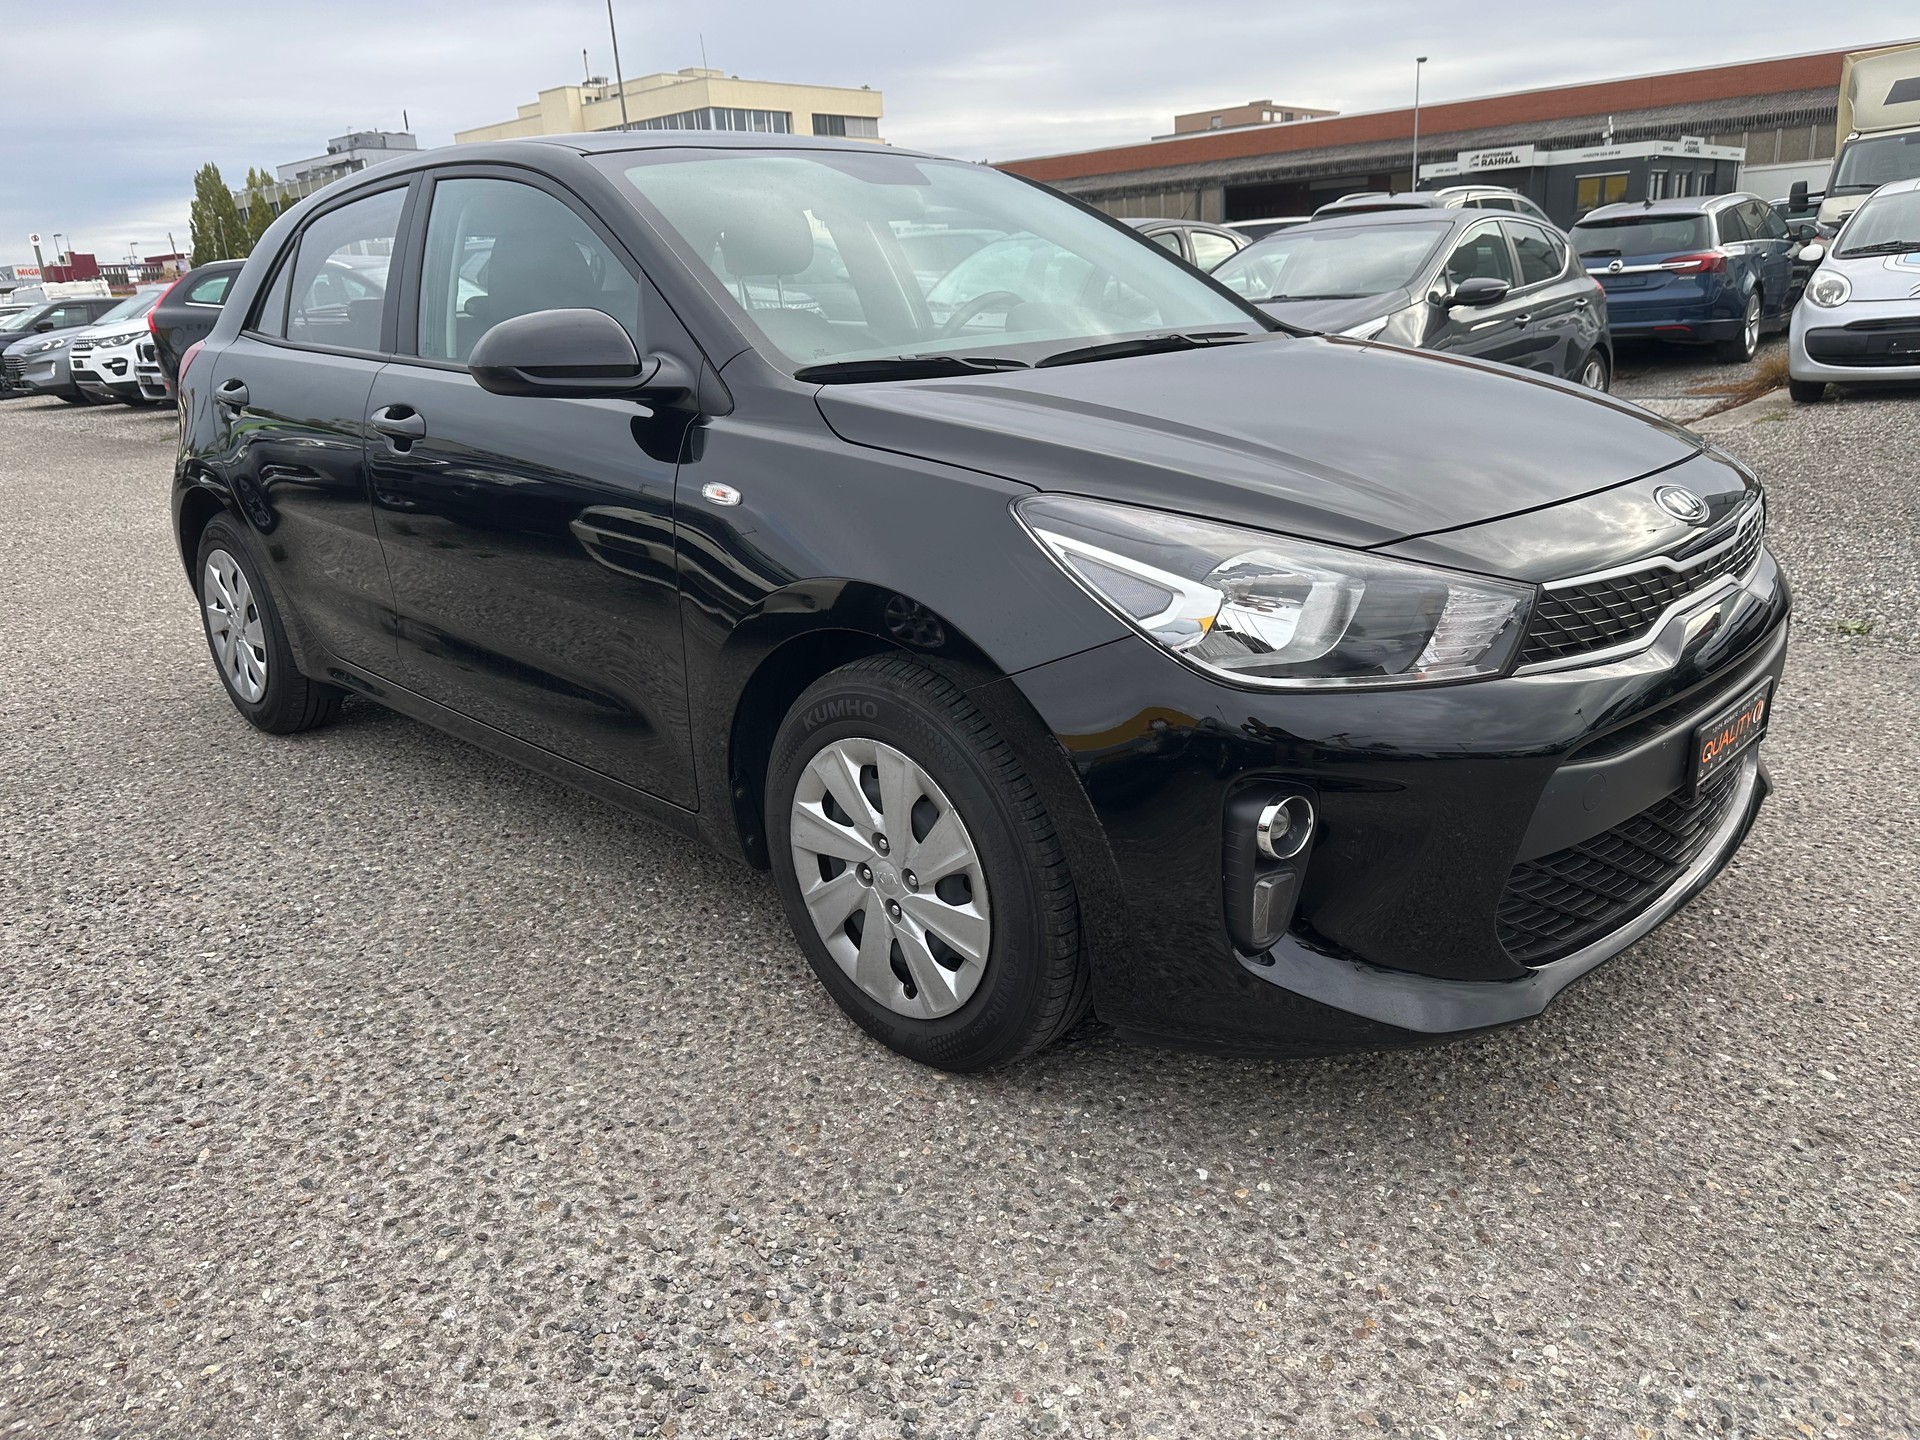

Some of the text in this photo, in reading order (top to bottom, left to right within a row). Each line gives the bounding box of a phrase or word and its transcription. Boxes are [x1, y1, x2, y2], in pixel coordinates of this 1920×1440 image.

[1481, 150, 1513, 159] AUTOPARK
[1481, 155, 1521, 167] RAHHAL
[802, 699, 878, 731] KUMHO
